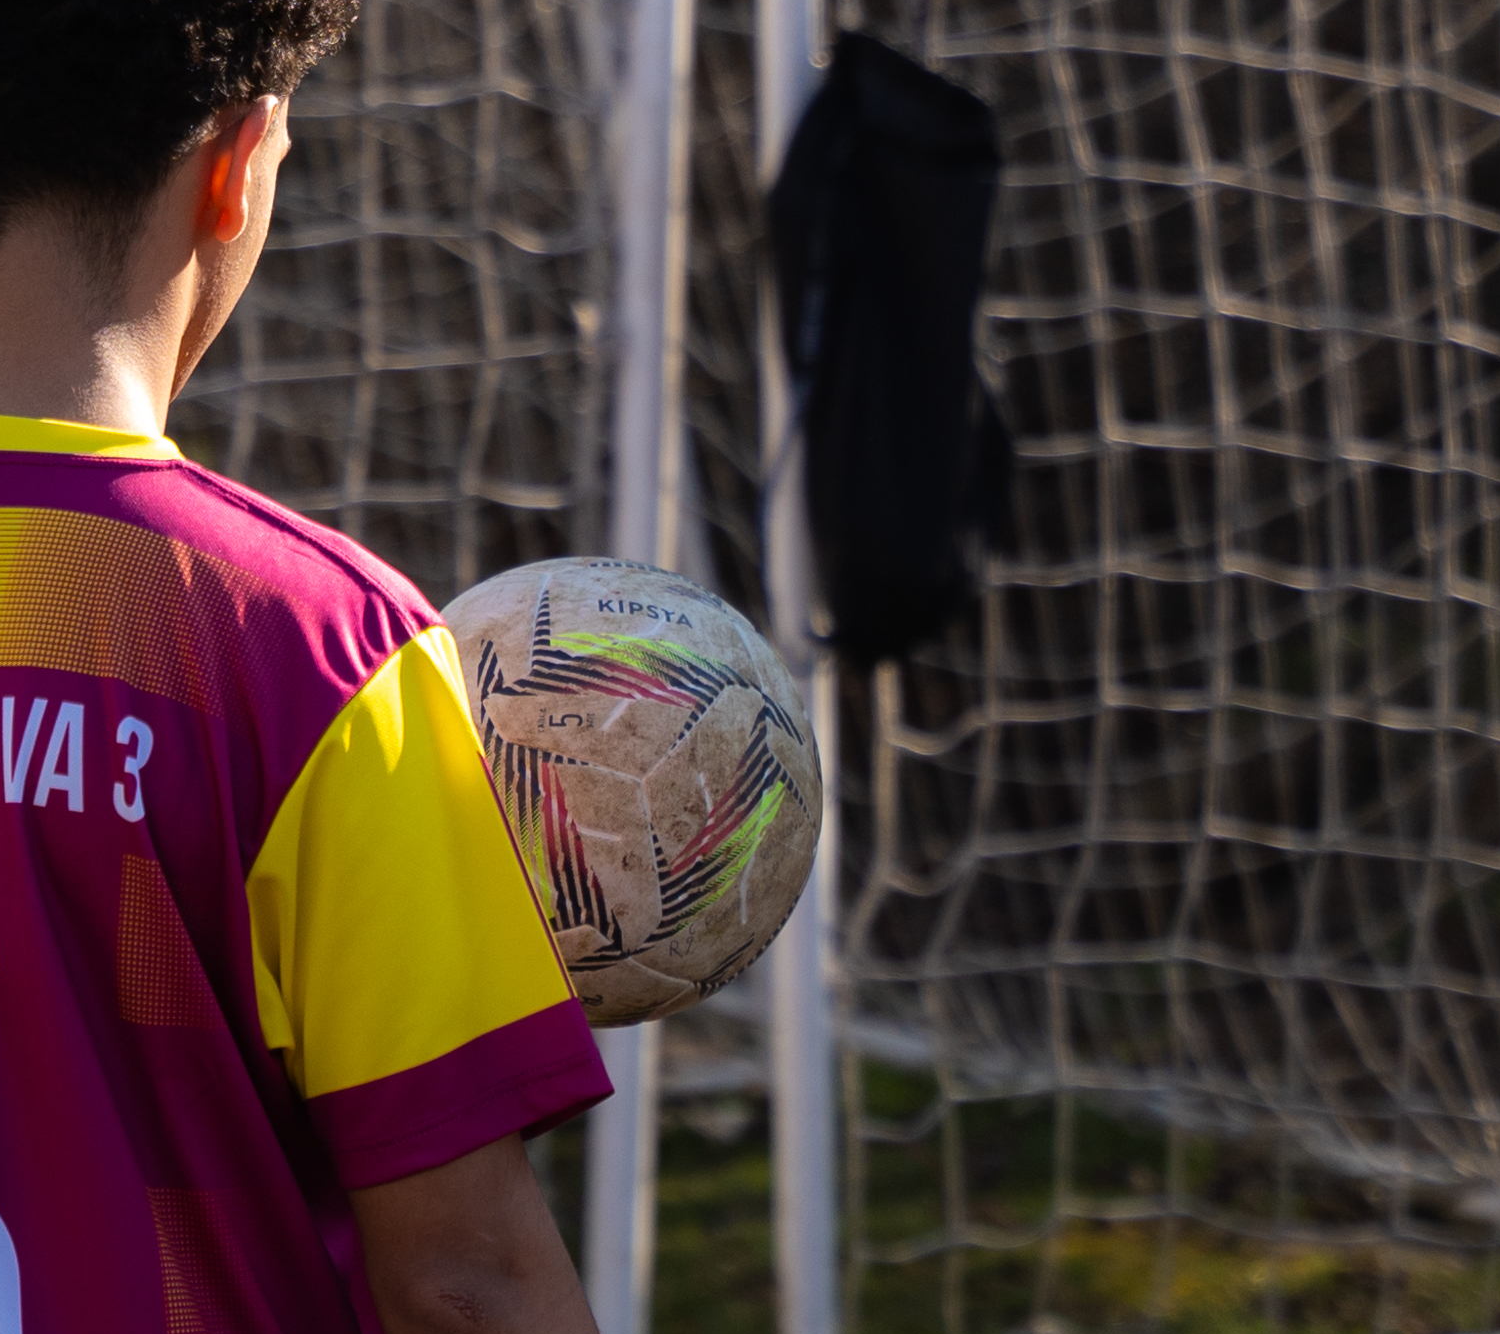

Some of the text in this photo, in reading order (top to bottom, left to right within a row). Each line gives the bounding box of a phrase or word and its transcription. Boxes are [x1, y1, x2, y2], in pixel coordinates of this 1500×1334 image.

[597, 599, 694, 629] KIPSTA
[548, 713, 584, 727] 5
[112, 716, 154, 824] 3
